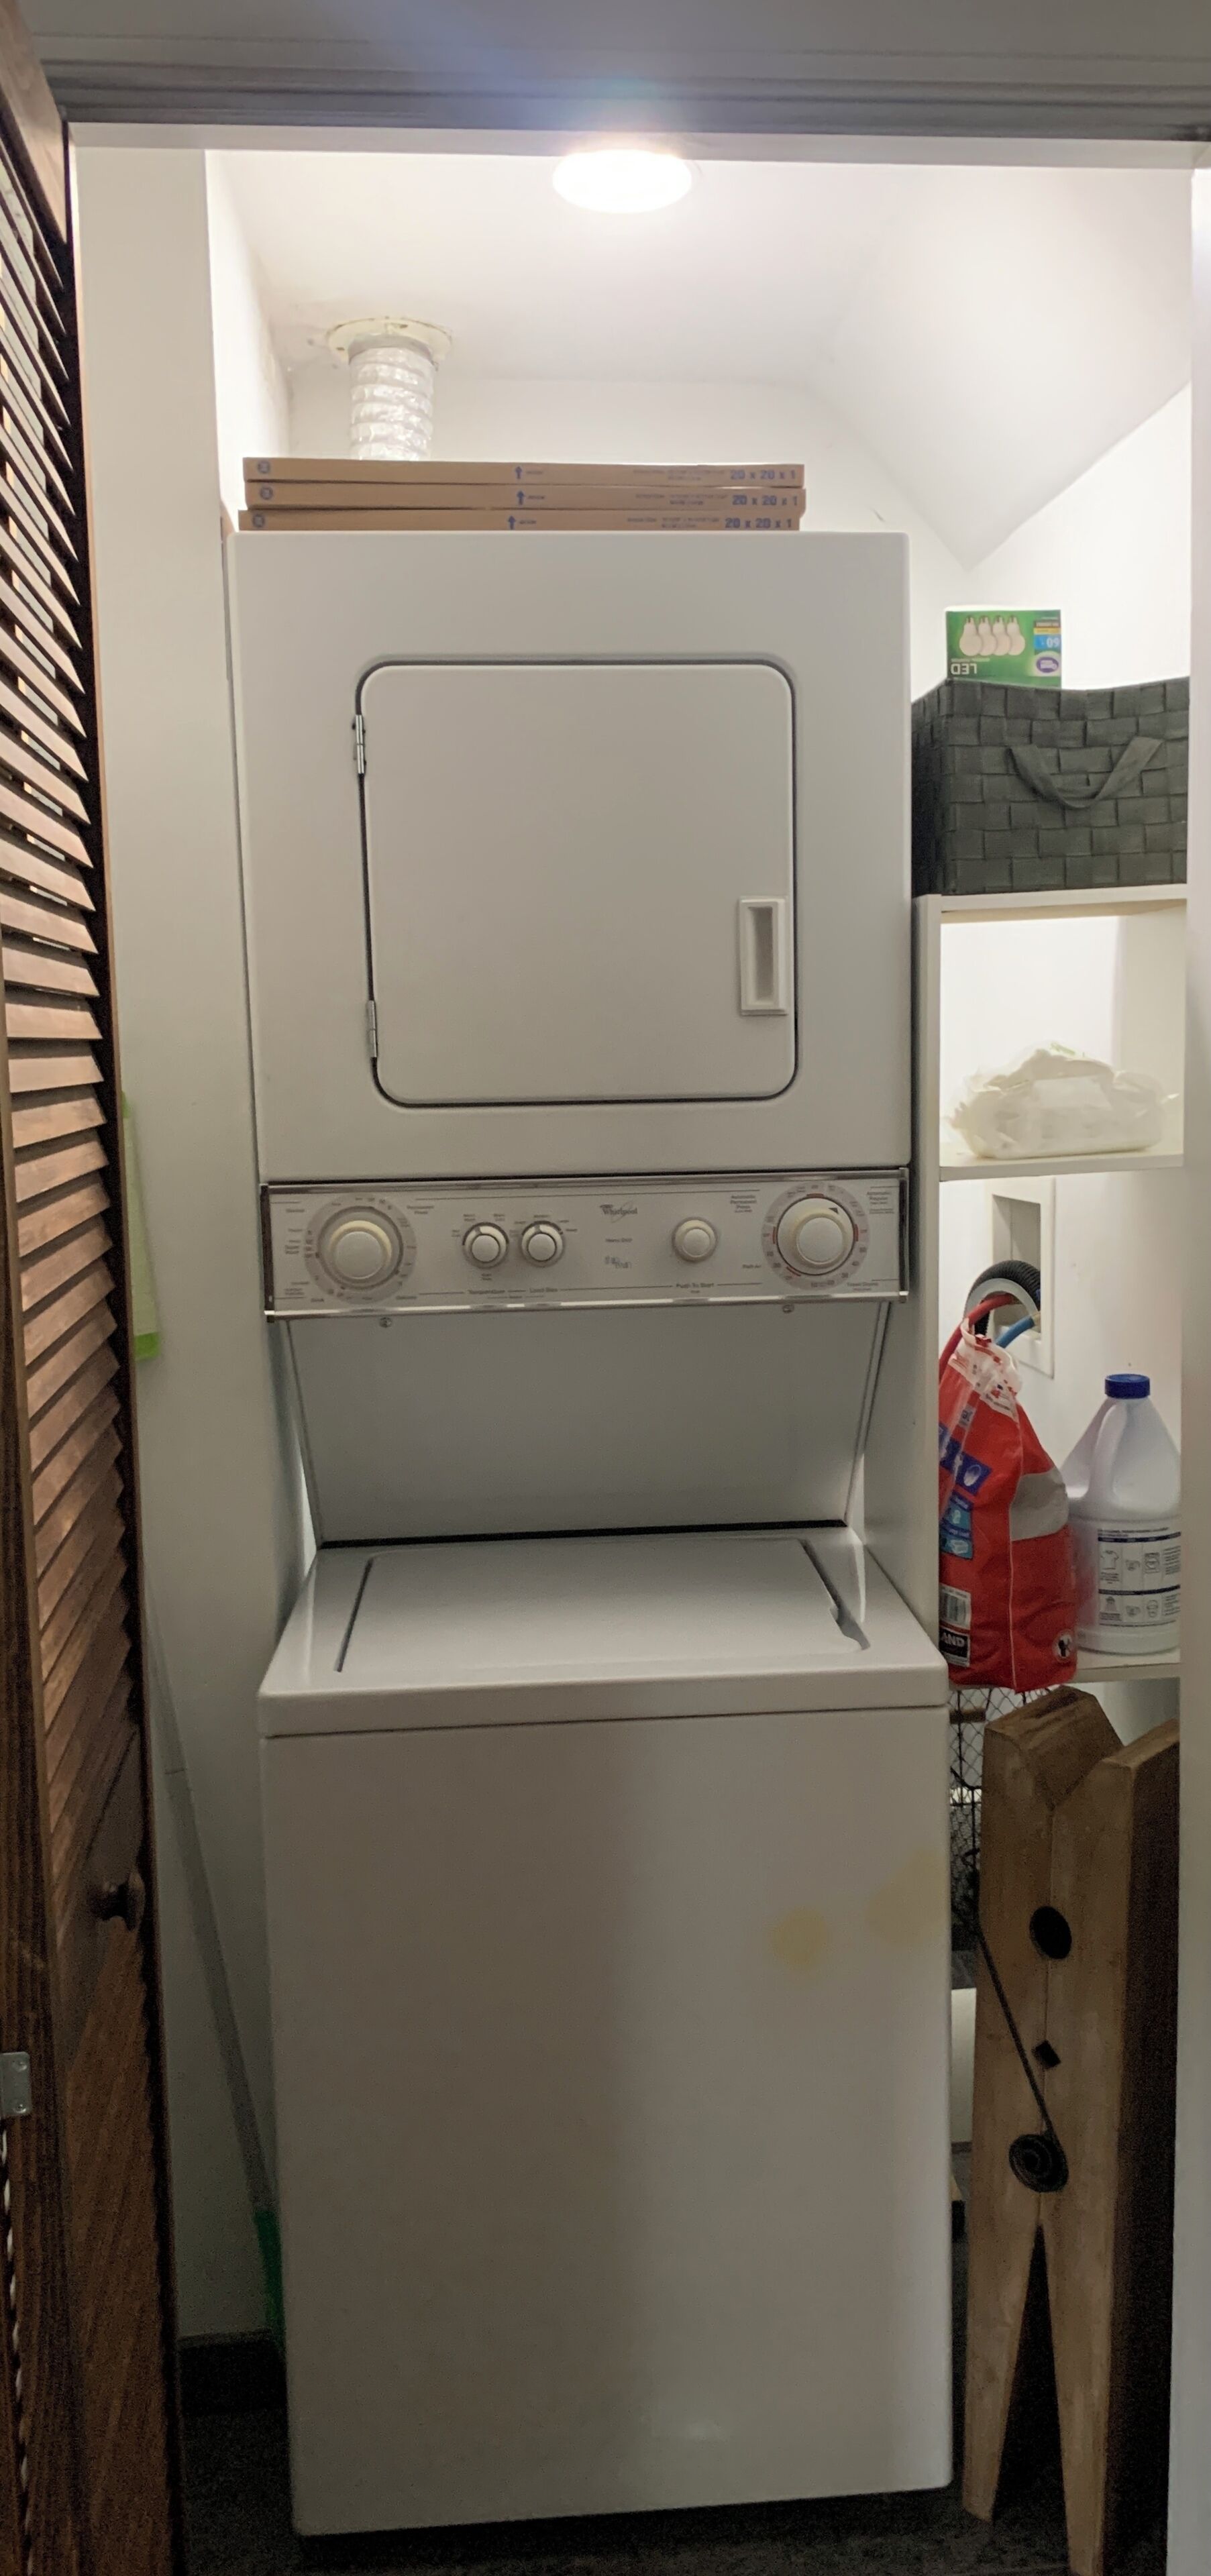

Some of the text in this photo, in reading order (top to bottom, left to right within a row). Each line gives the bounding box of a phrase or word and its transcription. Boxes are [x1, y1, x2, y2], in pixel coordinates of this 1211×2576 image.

[730, 469, 745, 480] 20
[750, 471, 755, 479] x
[760, 469, 775, 480] 20
[780, 471, 785, 479] x
[732, 495, 747, 506] 20
[752, 496, 757, 505] x
[761, 495, 777, 506] 20
[782, 496, 787, 505] x
[725, 518, 740, 529] 20
[745, 519, 751, 528] x
[755, 518, 771, 529] 20
[775, 519, 781, 528] x
[1046, 637, 1060, 648] 60
[951, 663, 978, 675] LED
[600, 1204, 637, 1216] Whirlpool
